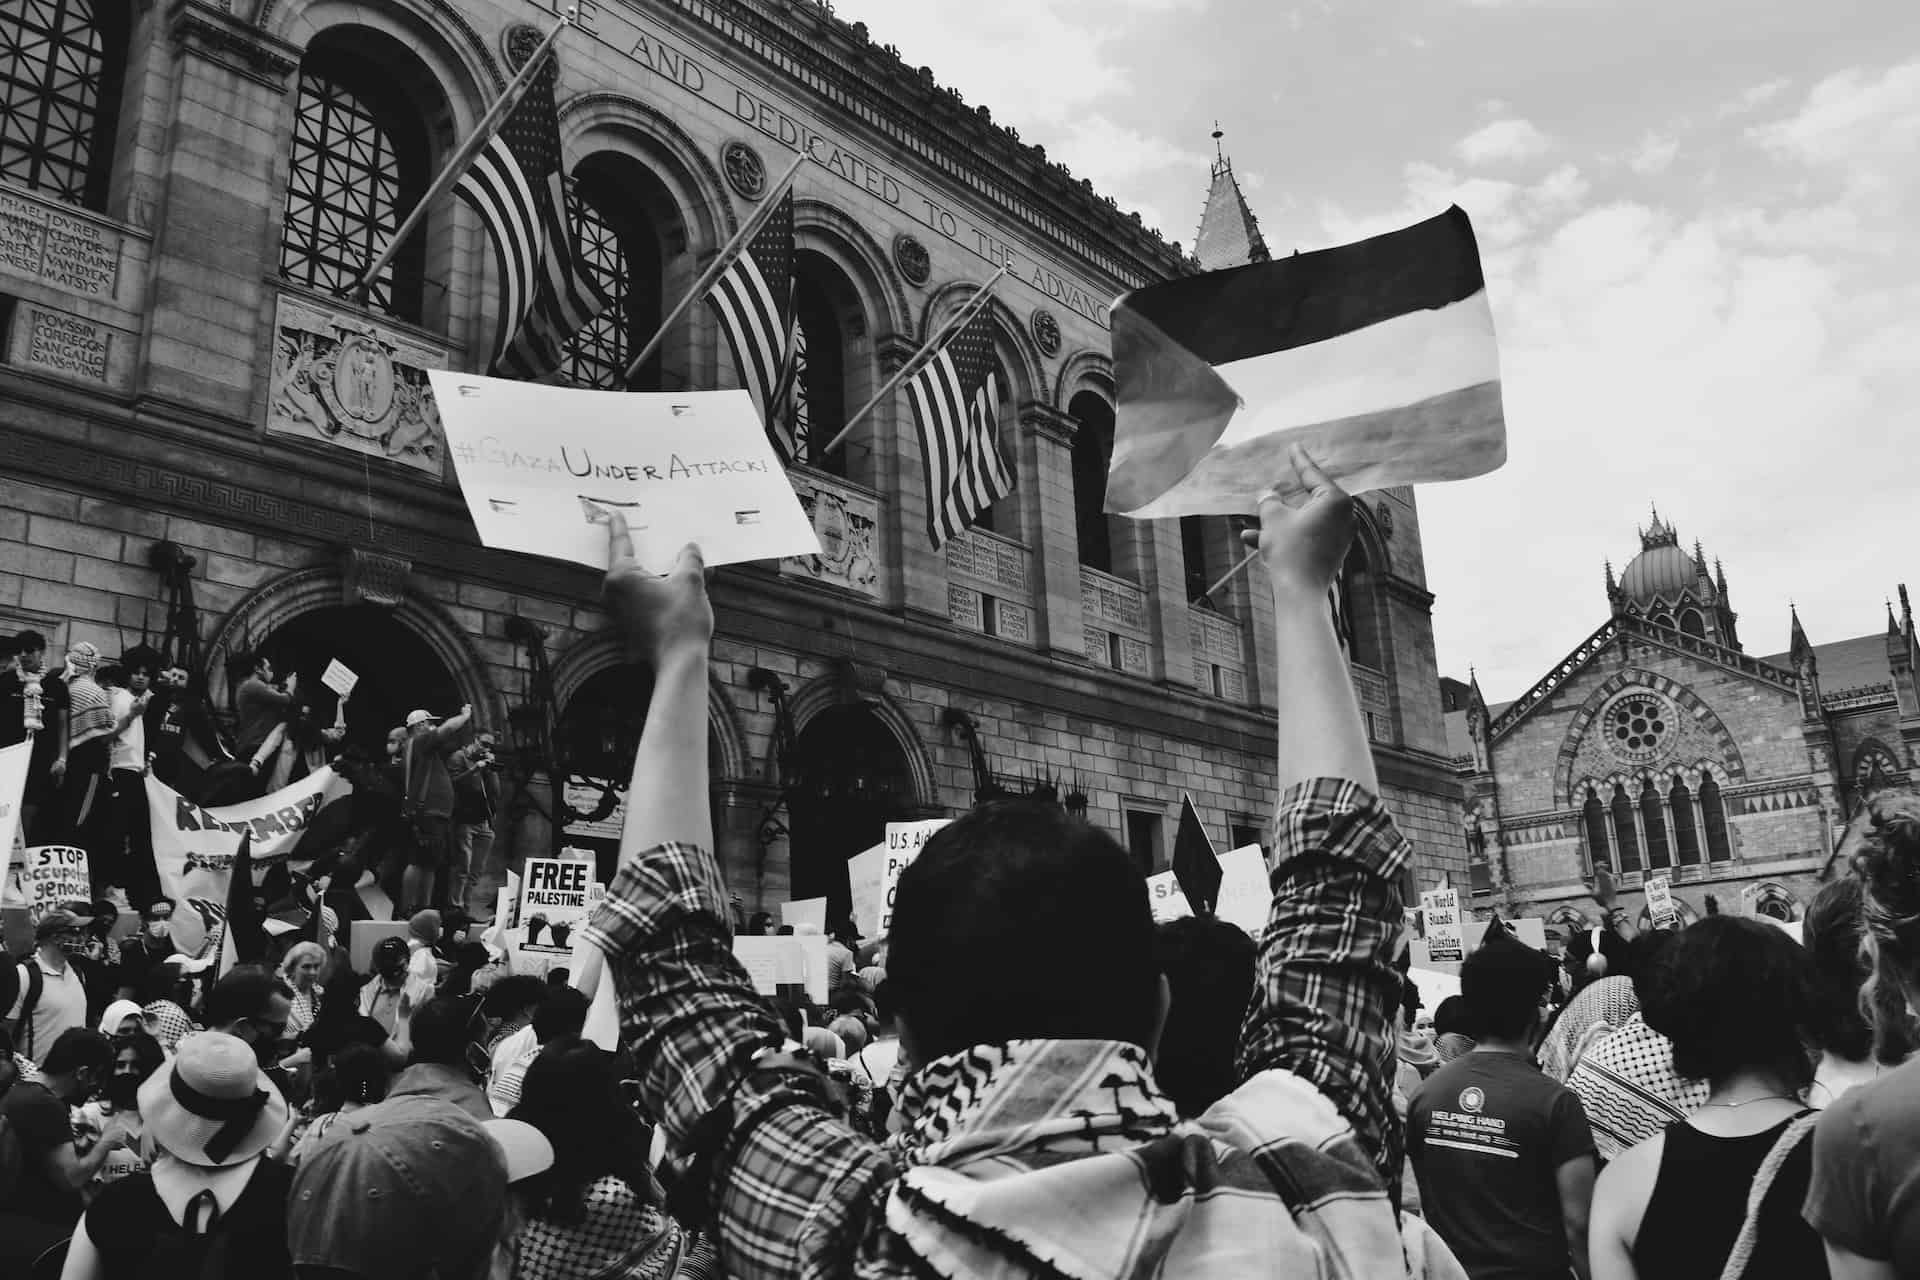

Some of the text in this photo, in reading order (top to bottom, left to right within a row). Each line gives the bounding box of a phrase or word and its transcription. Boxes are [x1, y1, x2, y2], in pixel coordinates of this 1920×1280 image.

[630, 35, 704, 92] AND
[735, 89, 900, 204] DEDICATED
[923, 199, 957, 237] TO
[972, 229, 1018, 275] THE
[890, 832, 910, 850] U.S.
[38, 848, 84, 867] STOP
[529, 862, 588, 891] FREE
[527, 891, 585, 907] PALESTINE
[1432, 892, 1456, 908] World
[1427, 935, 1462, 949] Palestine
[1431, 1110, 1475, 1124] HELPING
